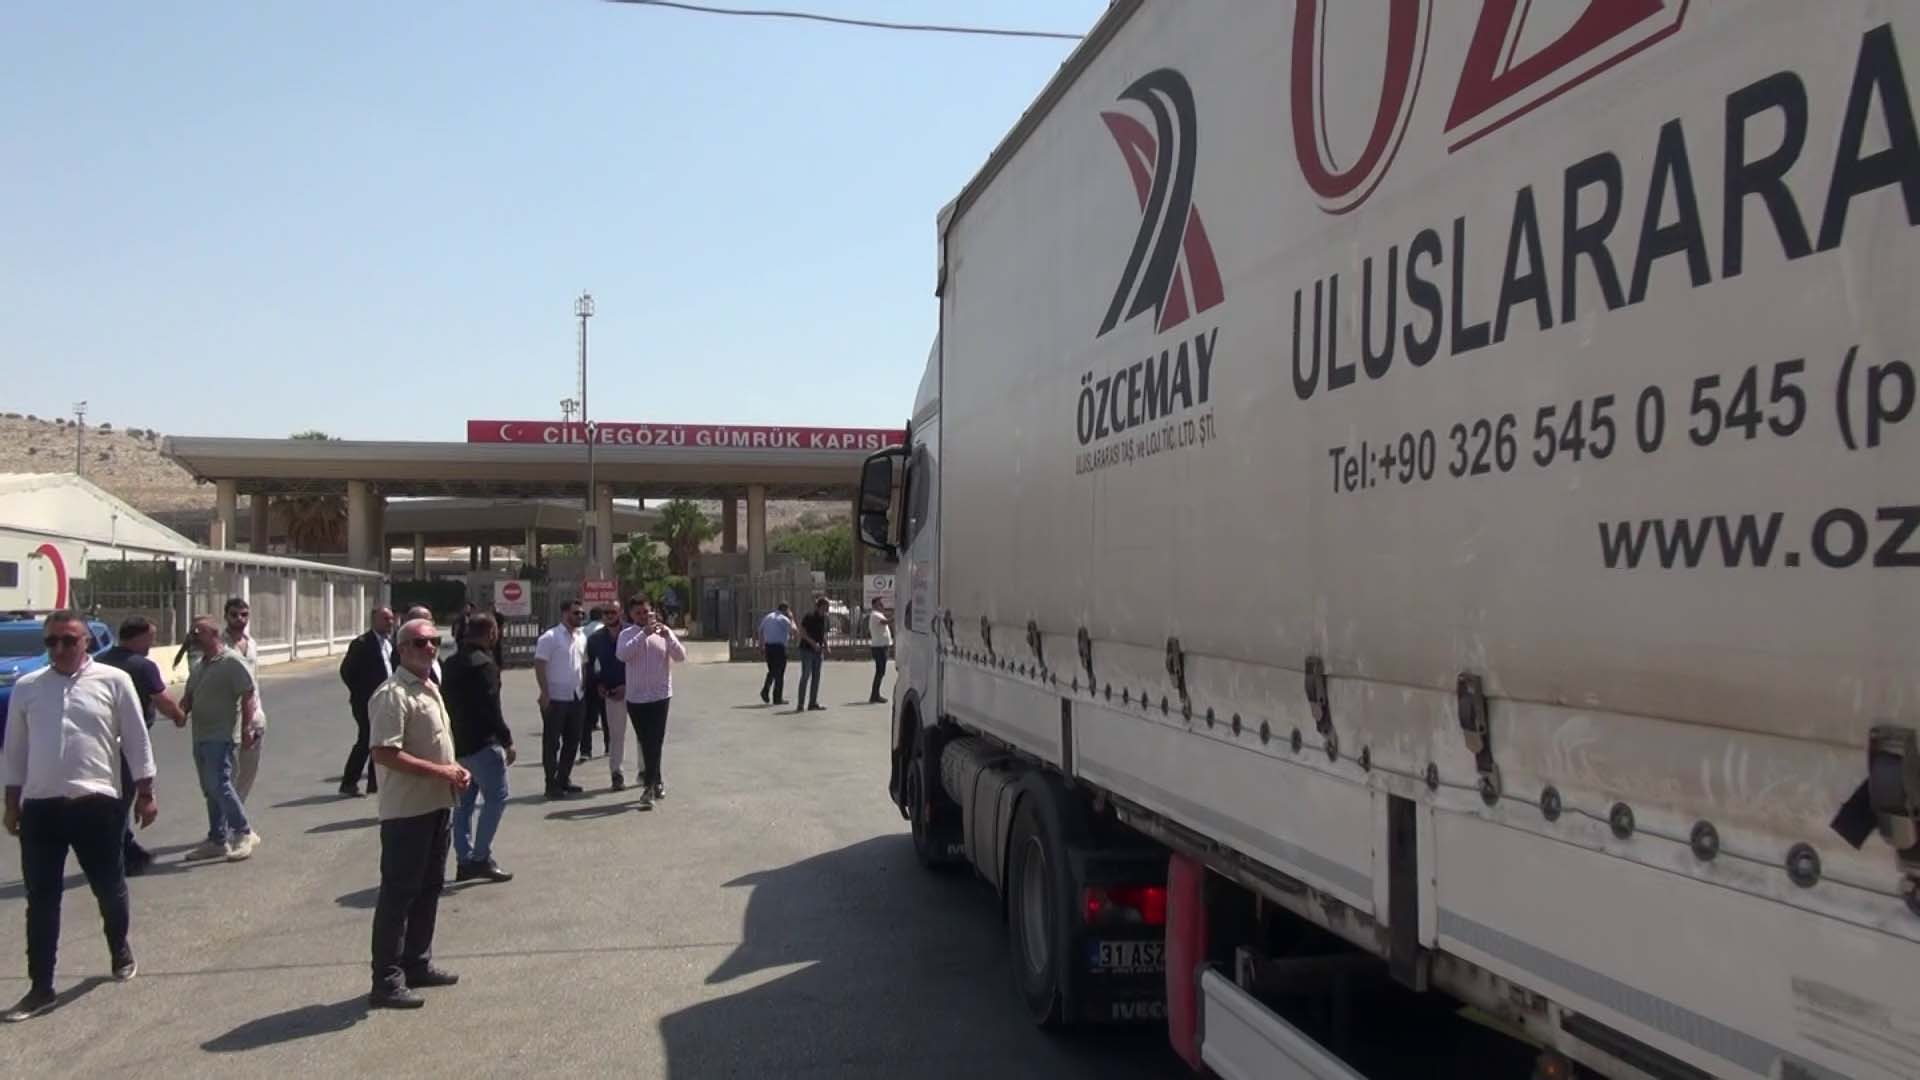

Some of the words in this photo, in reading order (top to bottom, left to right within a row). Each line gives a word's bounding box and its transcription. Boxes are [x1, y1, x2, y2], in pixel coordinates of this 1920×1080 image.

[1291, 22, 1920, 400] ULUSLARARA
[1076, 326, 1219, 446] ÖZCEMAY
[1329, 428, 1436, 493] Tel:+90
[1448, 413, 1517, 479] 326
[1532, 393, 1616, 467] 545
[1636, 385, 1665, 454] 0
[1688, 357, 1807, 447] 545
[543, 424, 686, 445] CİLVEGÖZÜ
[695, 426, 801, 448] GÜMRÜK
[810, 433, 890, 450] KAPISI
[1598, 505, 1920, 569] www.oz
[1102, 943, 1122, 965] 31
